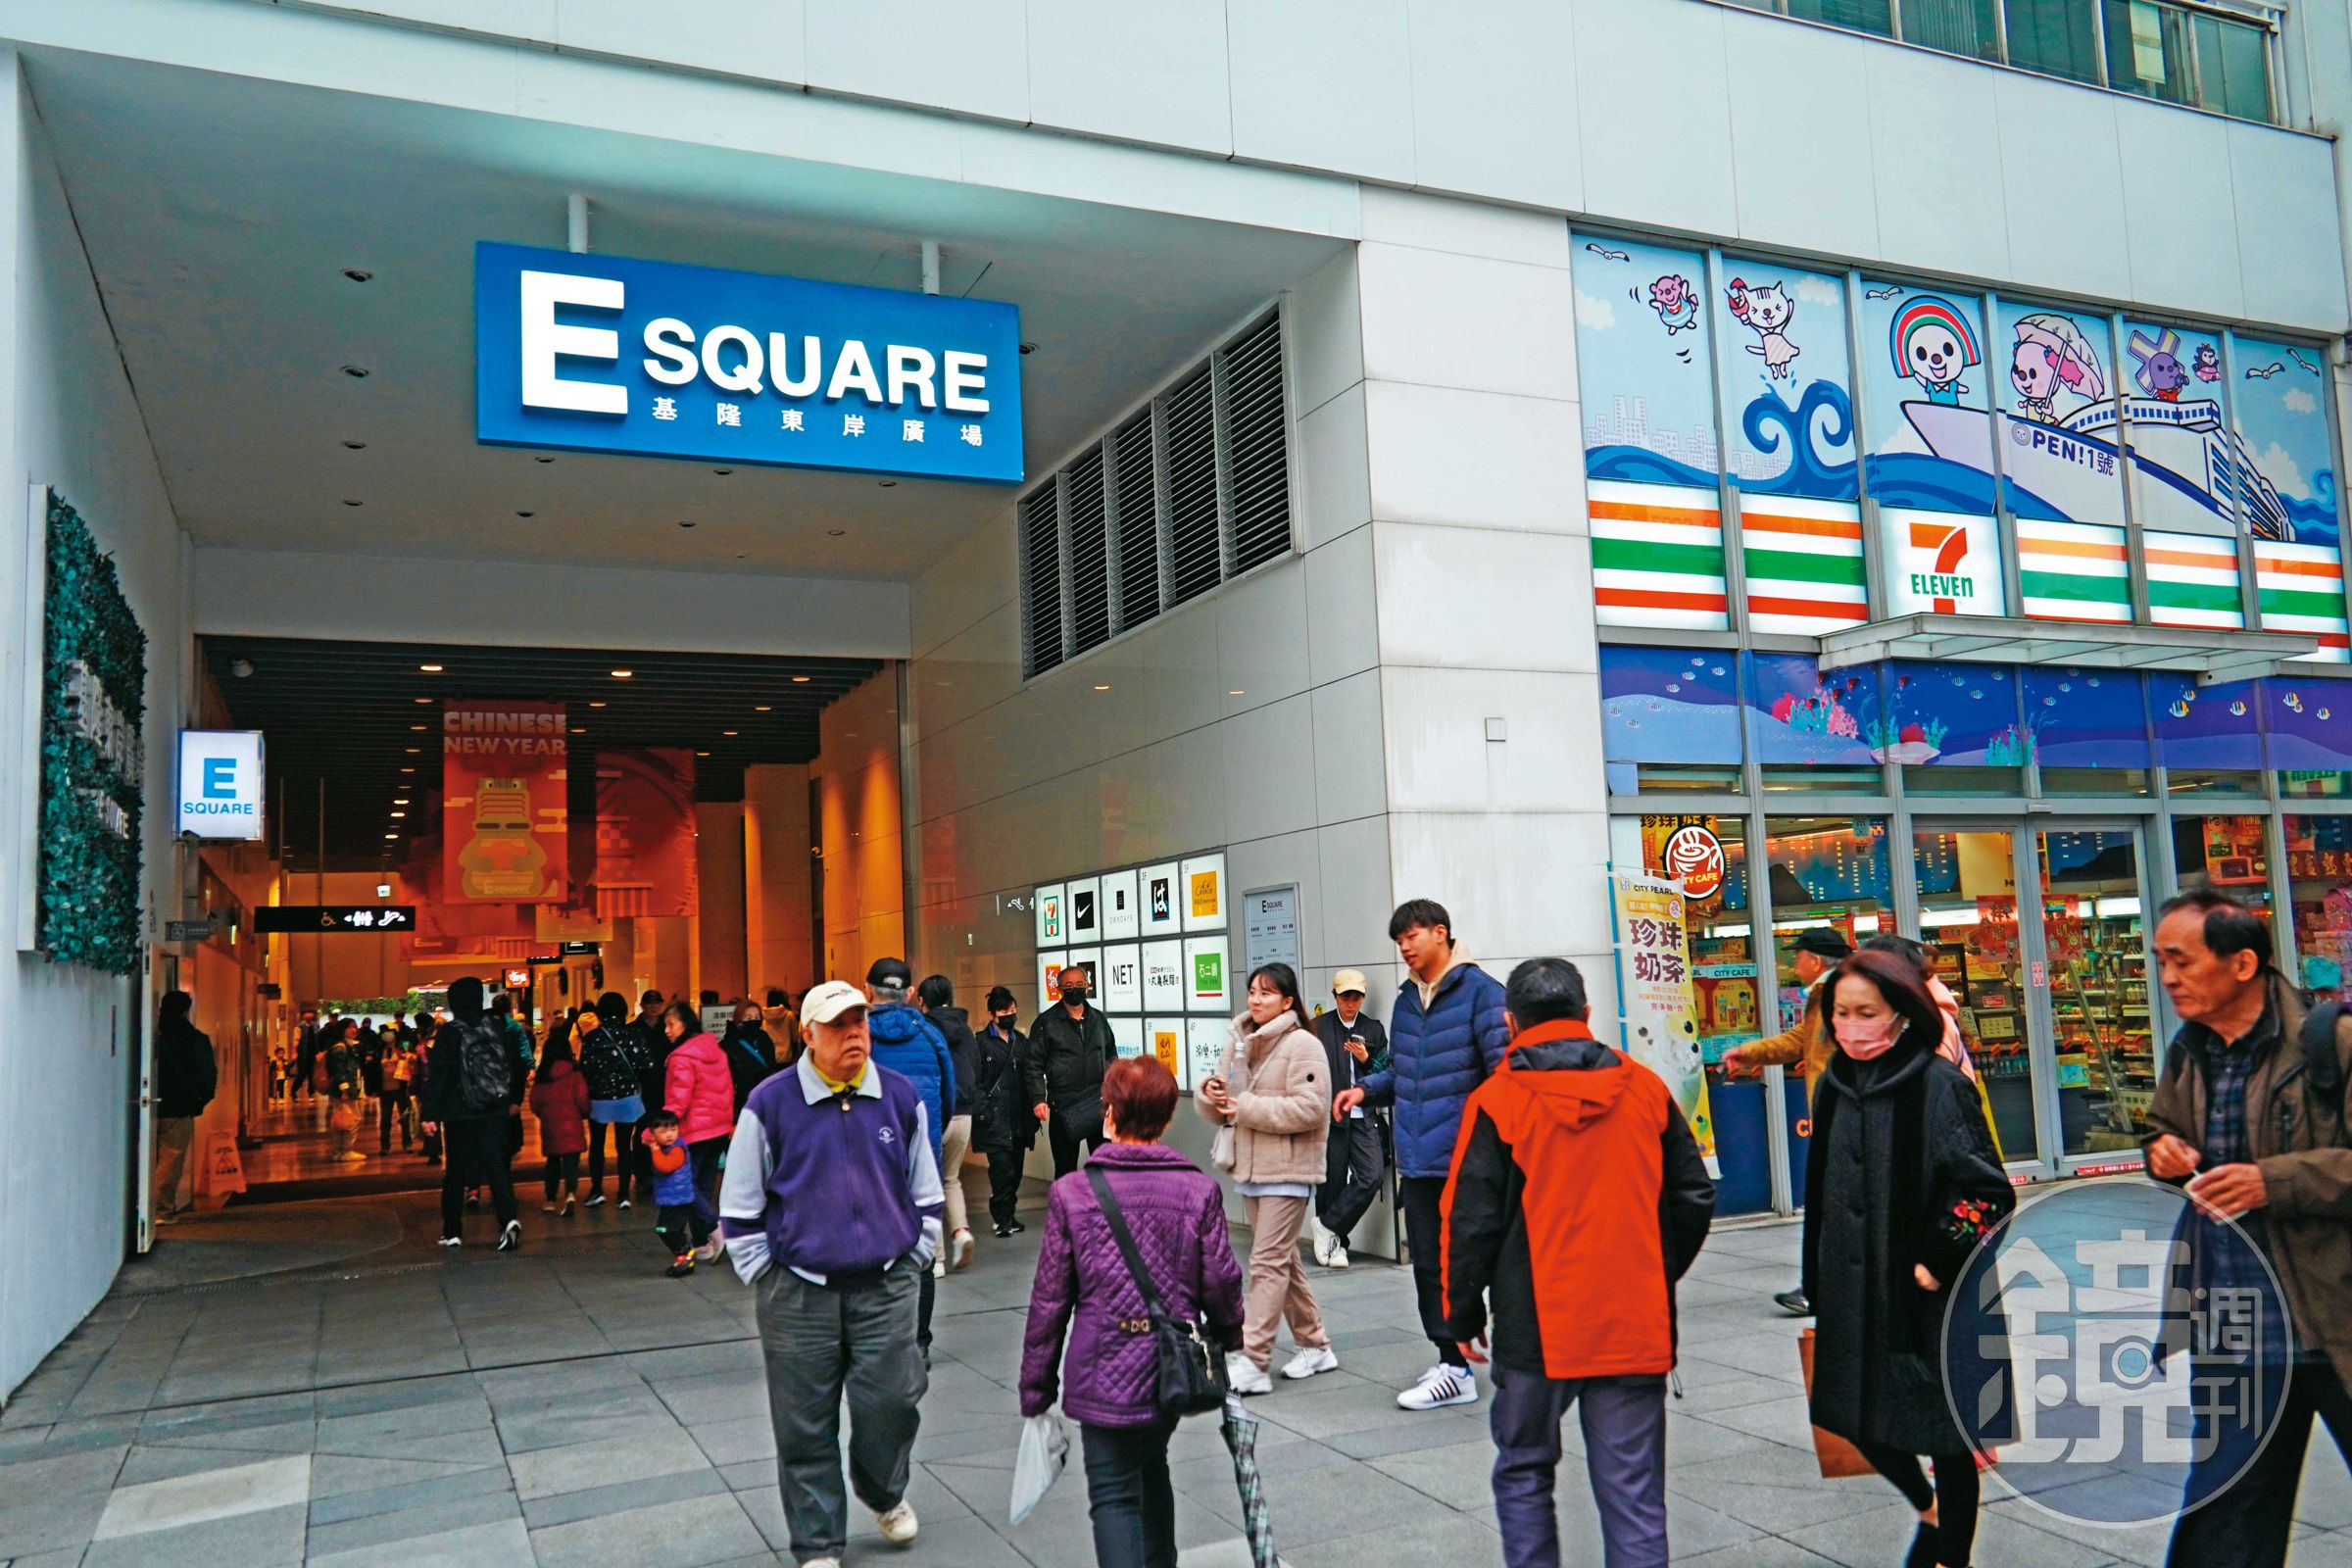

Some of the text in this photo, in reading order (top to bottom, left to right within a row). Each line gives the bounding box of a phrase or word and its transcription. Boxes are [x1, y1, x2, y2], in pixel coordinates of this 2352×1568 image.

[643, 318, 990, 413] SQUARE
[652, 396, 984, 447] 基隆東岸廣場
[444, 711, 566, 734] CHINESE
[444, 737, 567, 756] NEW YEAR
[203, 758, 237, 799] E
[183, 802, 254, 814] SQUARE
[1695, 872, 1718, 882] CAFE
[1112, 964, 1134, 985] NET
[1634, 952, 1686, 983] 奶茶
